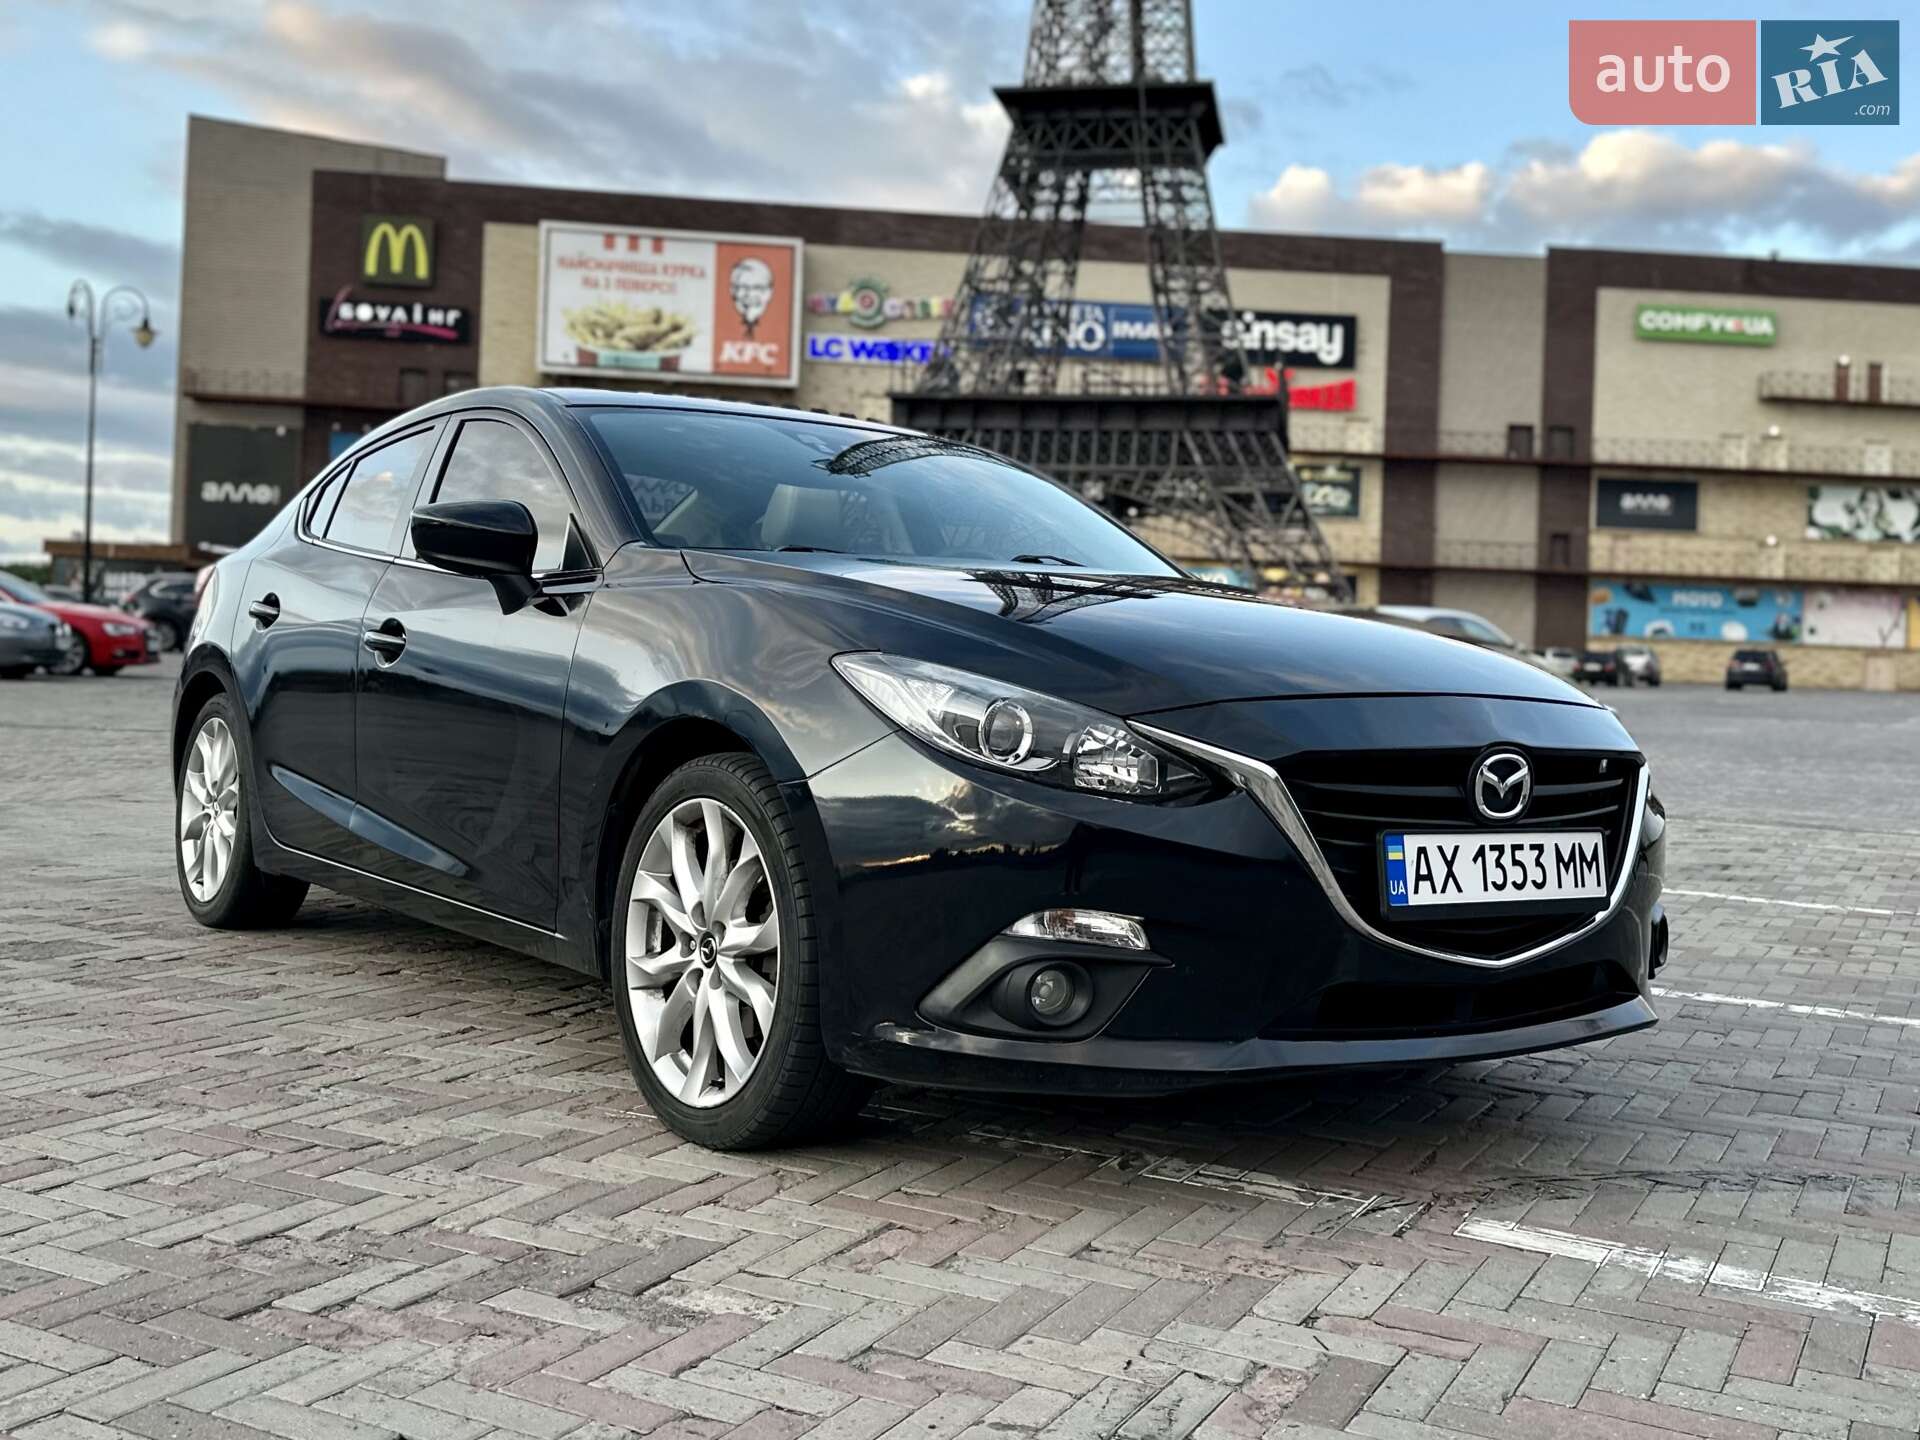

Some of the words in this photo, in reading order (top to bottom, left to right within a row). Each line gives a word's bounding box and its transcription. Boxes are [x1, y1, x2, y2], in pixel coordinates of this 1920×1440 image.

[810, 337, 842, 358] LC
[1221, 311, 1344, 365] sinsay
[719, 341, 779, 365] KFC
[1413, 844, 1463, 894] AX
[1472, 843, 1547, 891] 1353
[1554, 842, 1602, 889] MM
[1390, 880, 1406, 895] UA
